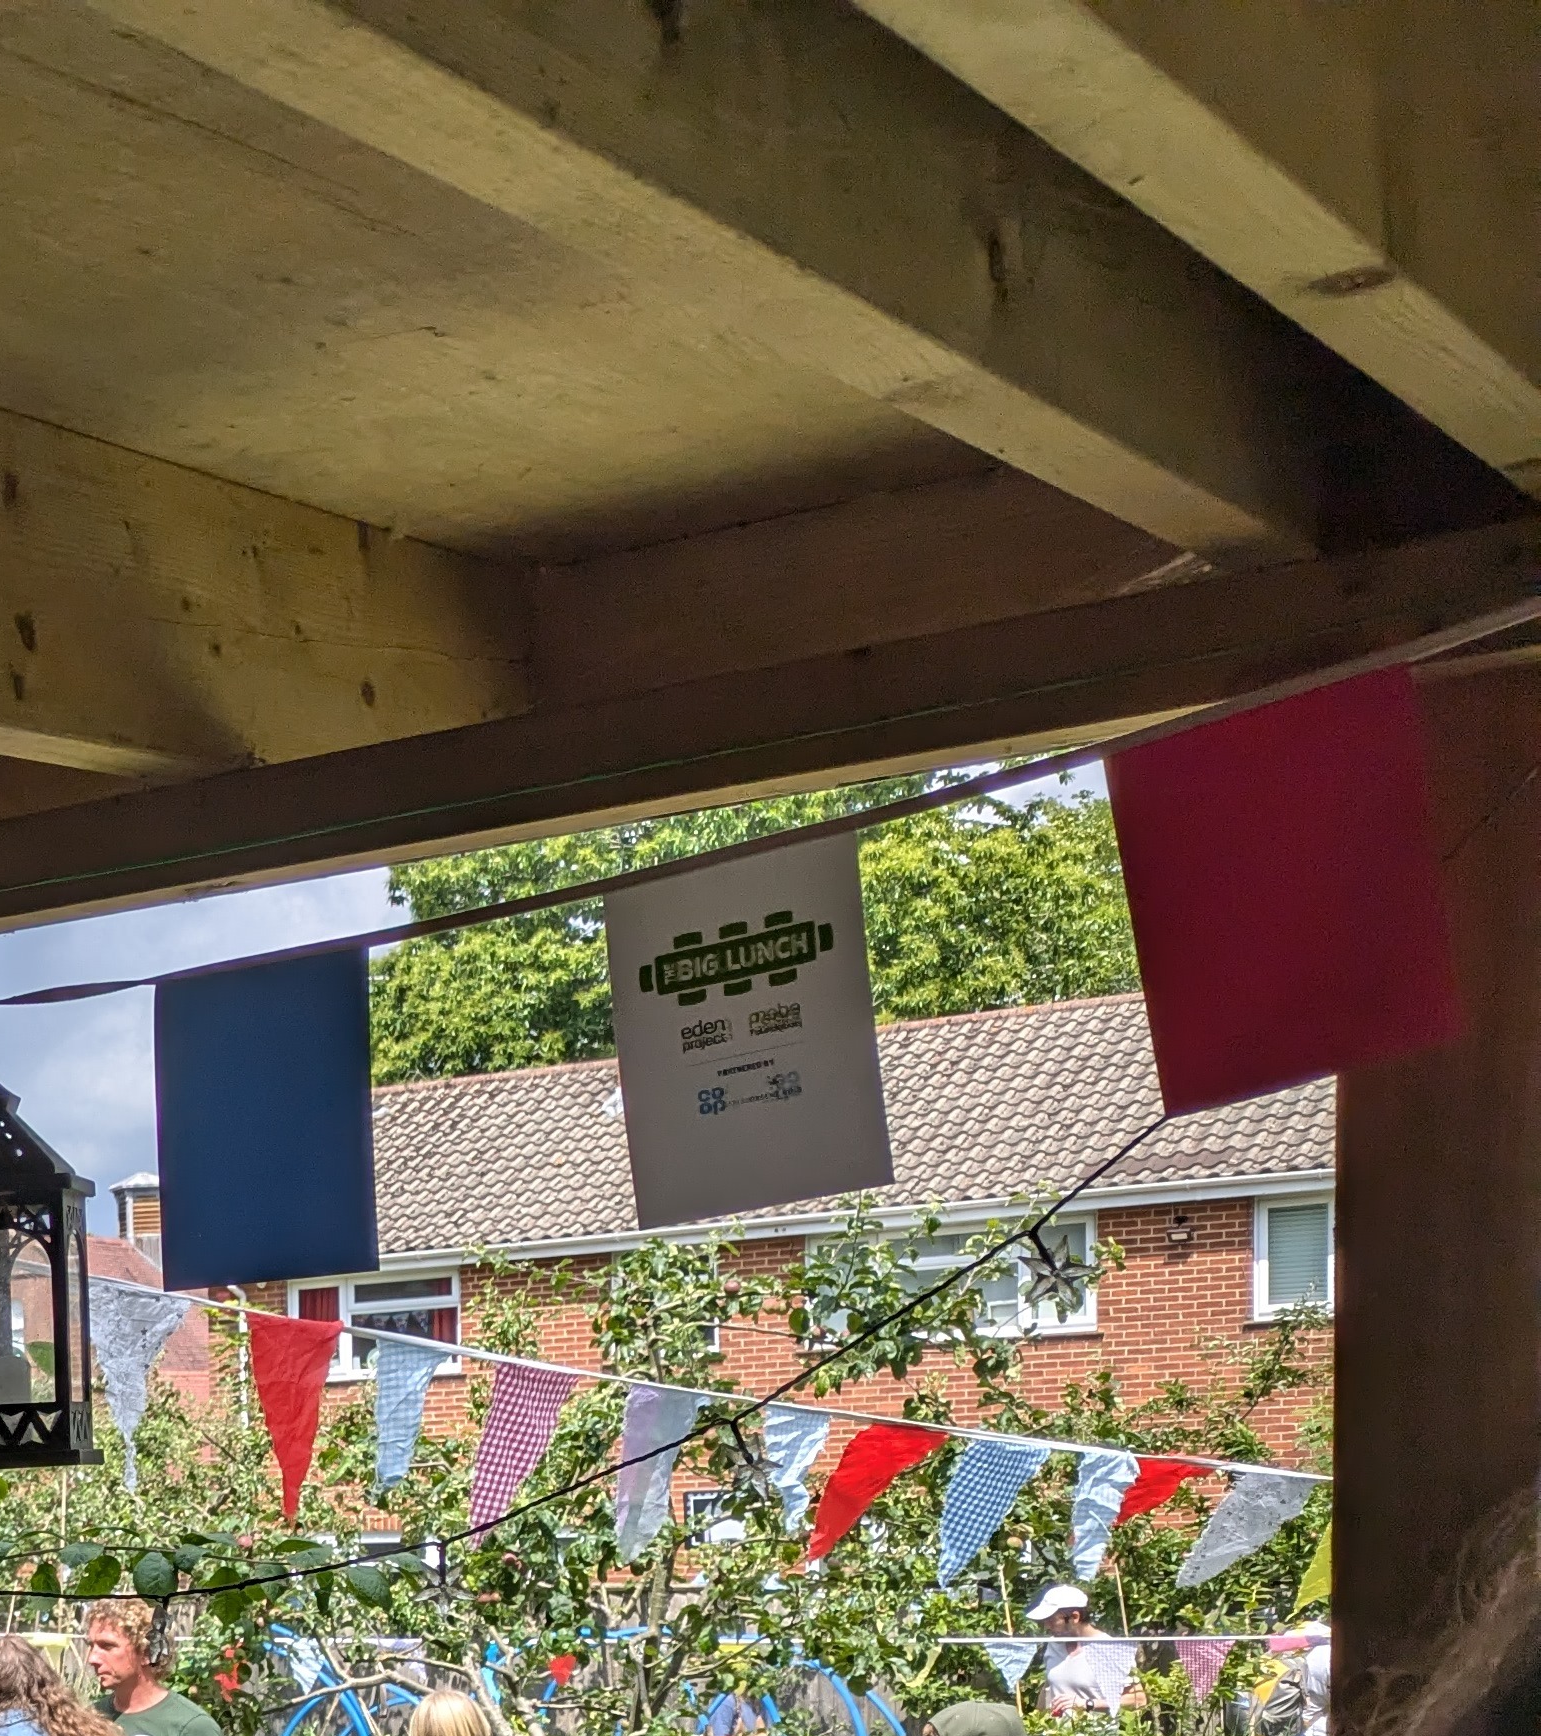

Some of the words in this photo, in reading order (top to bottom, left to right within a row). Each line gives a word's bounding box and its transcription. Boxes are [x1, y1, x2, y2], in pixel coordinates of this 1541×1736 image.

[677, 951, 719, 982] BIG
[725, 930, 809, 970] LUNCH
[681, 1019, 727, 1040] eden
[682, 1032, 729, 1054] project
